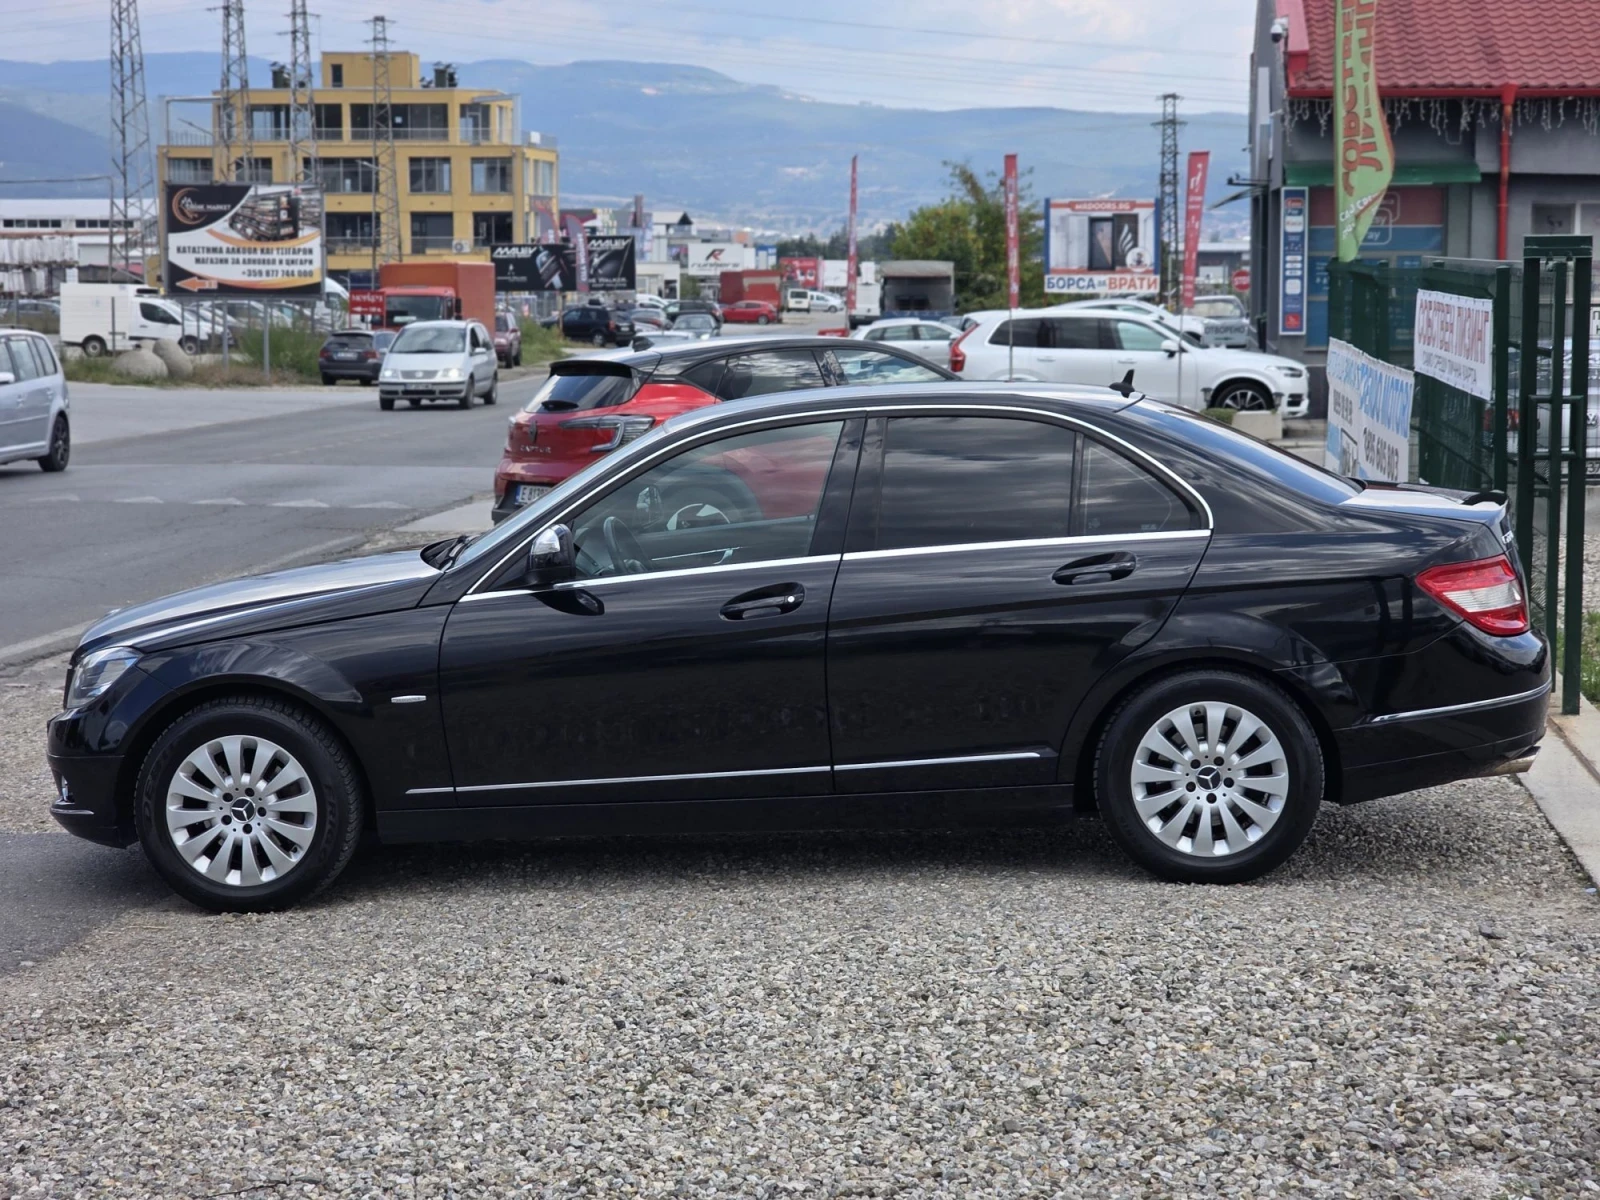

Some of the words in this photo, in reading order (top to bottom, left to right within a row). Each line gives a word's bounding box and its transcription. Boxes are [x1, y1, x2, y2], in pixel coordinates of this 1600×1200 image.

[285, 259, 313, 267] ЦИГАРИ
[1047, 277, 1096, 289] БОРСА
[1108, 277, 1158, 290] ВРАТИ
